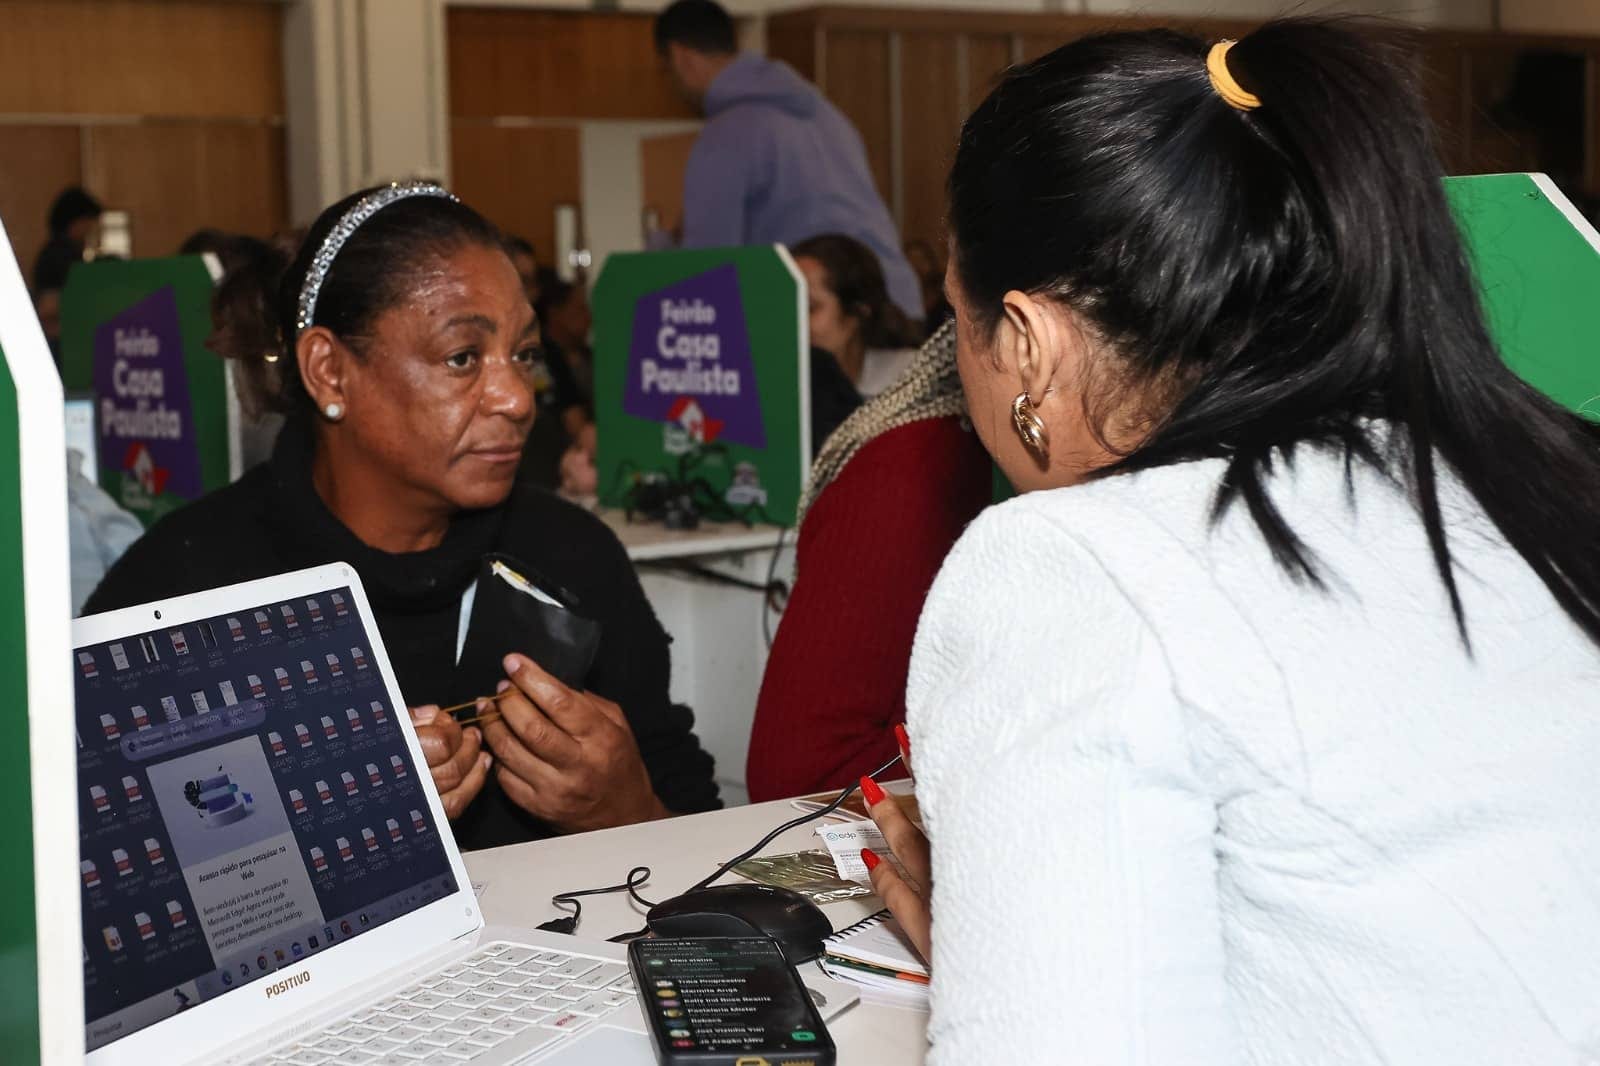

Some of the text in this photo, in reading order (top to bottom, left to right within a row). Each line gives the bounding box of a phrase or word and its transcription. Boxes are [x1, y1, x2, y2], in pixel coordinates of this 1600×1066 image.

[657, 326, 720, 359] Casa
[113, 360, 164, 397] Casa
[641, 359, 741, 395] Paulista
[102, 398, 182, 439] Paulista
[240, 871, 255, 881] Web
[265, 970, 311, 999] POSITIVO
